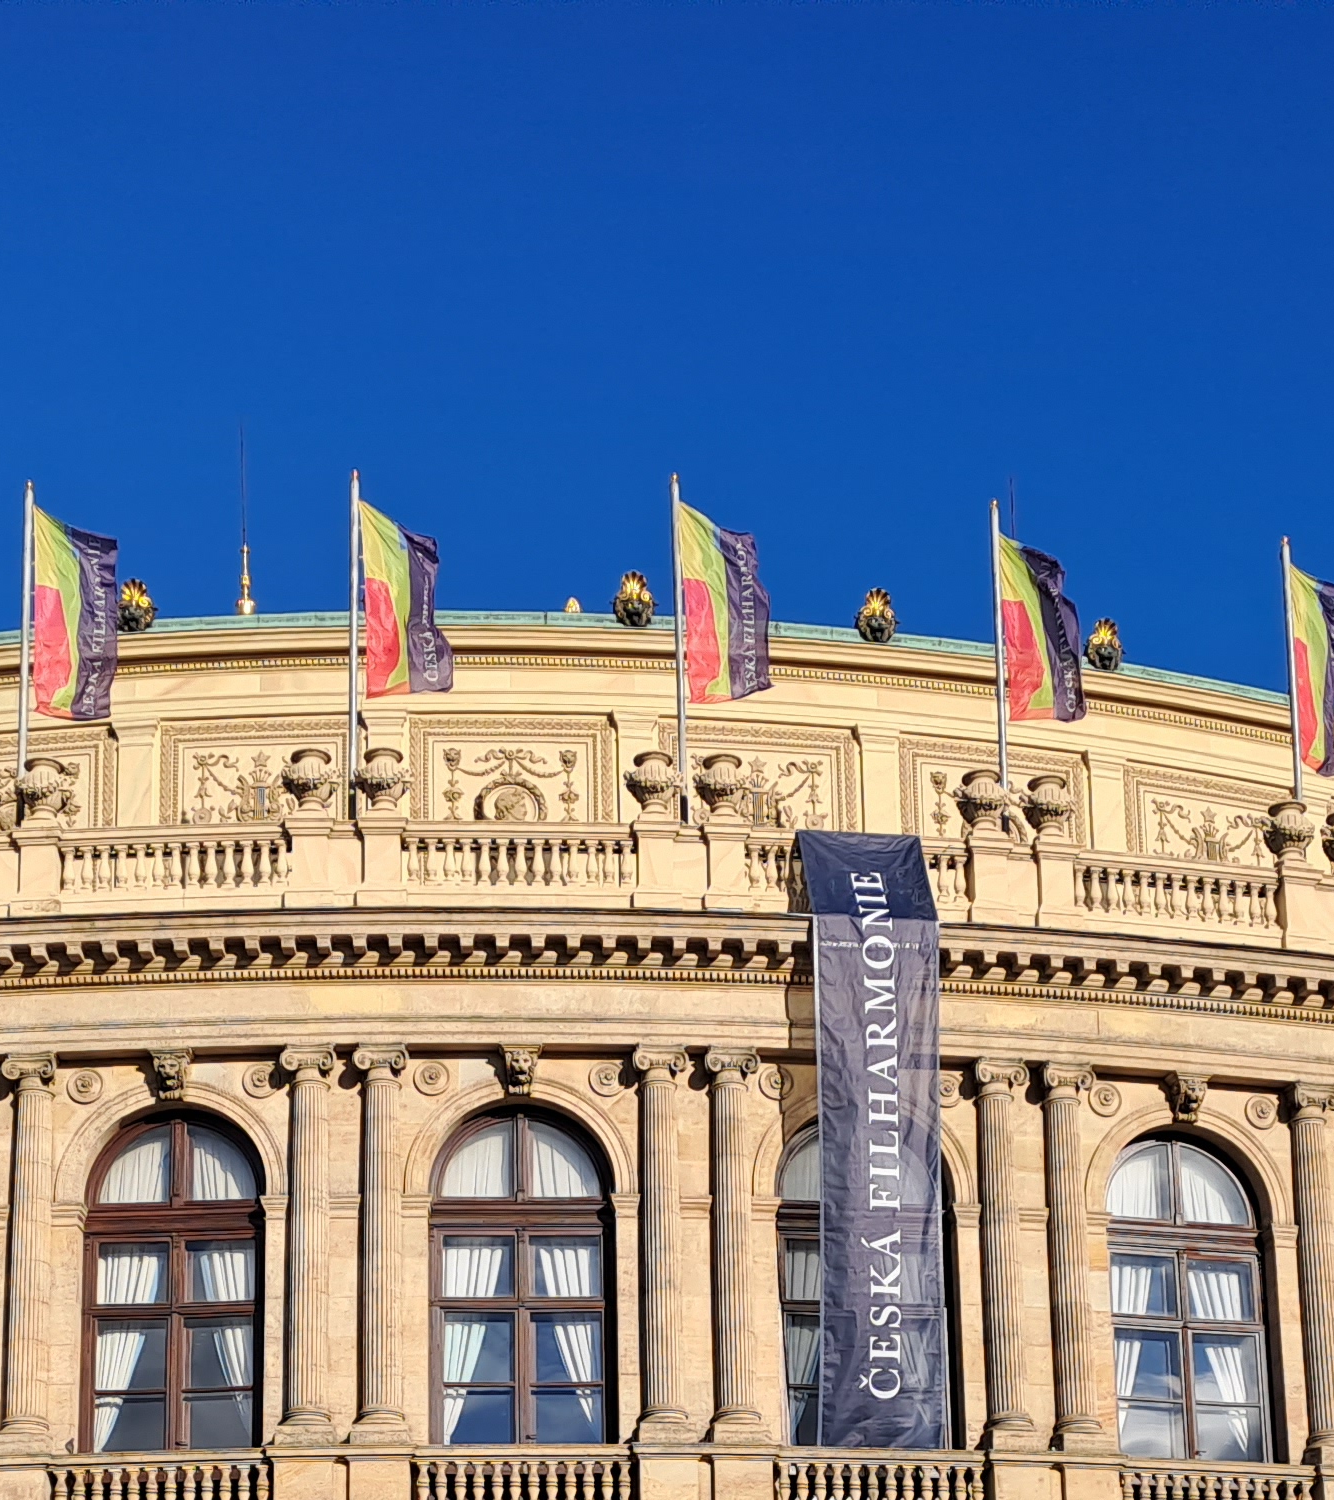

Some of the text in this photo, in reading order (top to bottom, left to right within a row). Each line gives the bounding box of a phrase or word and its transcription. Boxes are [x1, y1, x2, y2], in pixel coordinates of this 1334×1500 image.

[418, 632, 439, 682] ČESKÁ
[851, 872, 902, 1400] ČESKÁ FILHARMONIE
